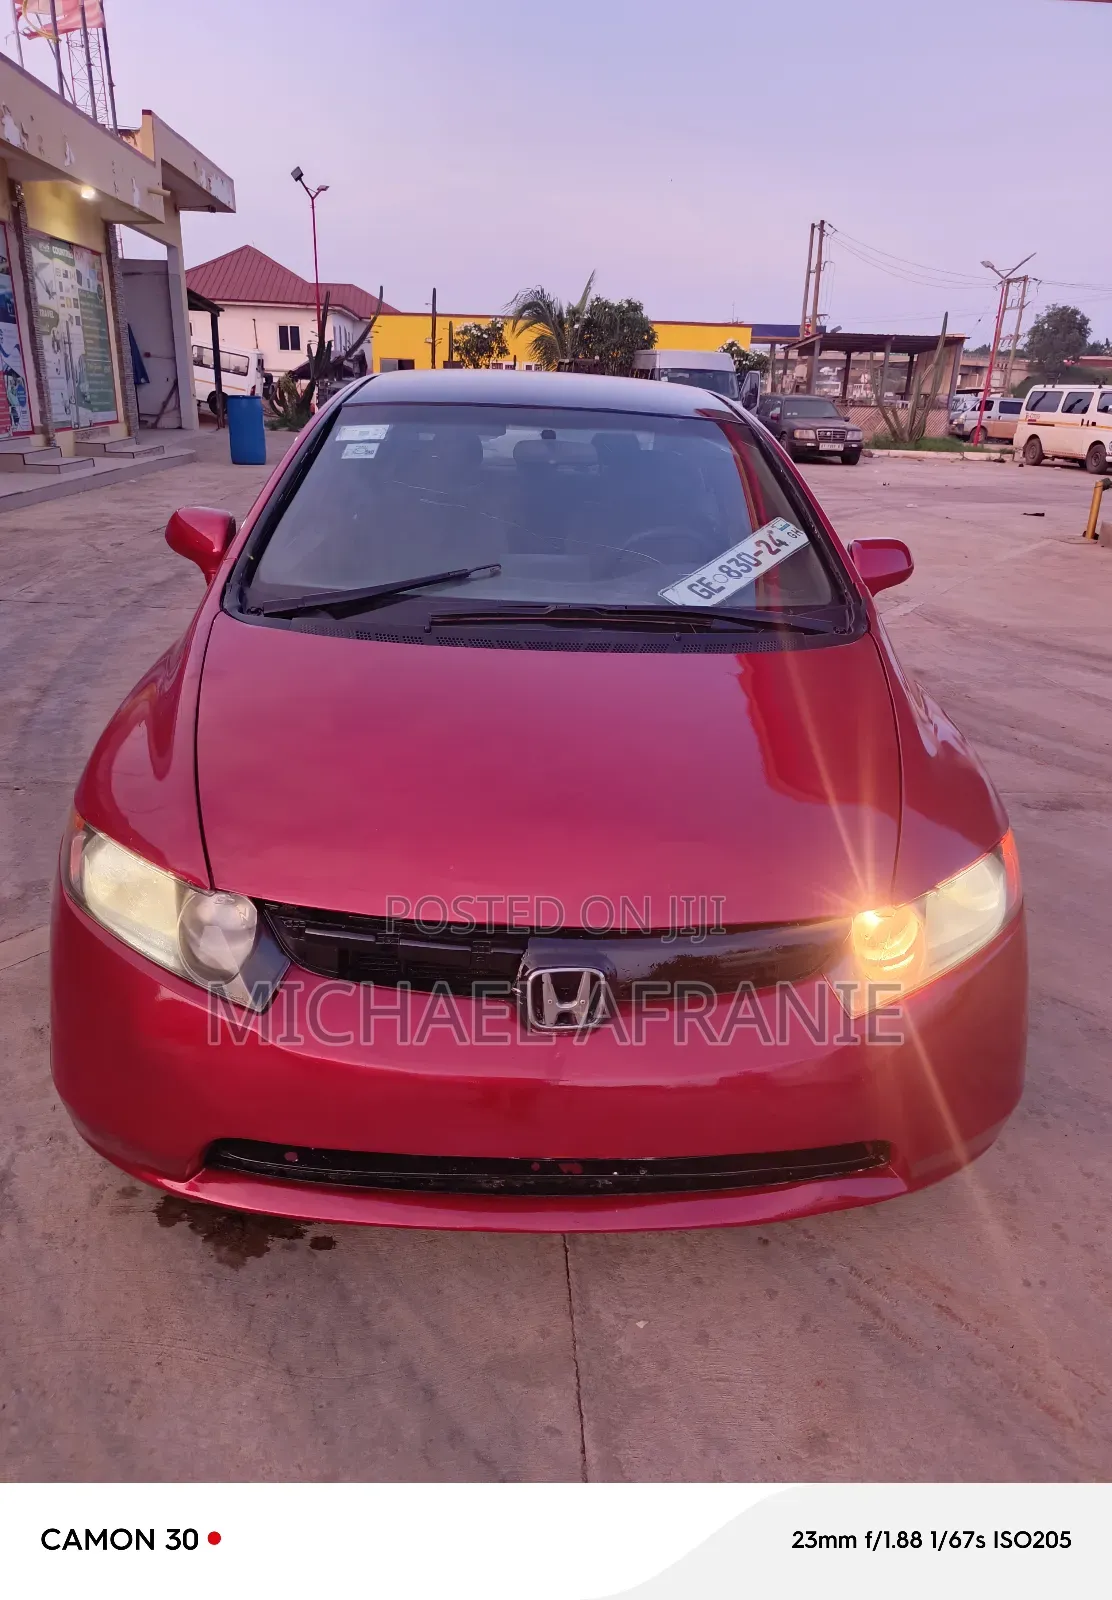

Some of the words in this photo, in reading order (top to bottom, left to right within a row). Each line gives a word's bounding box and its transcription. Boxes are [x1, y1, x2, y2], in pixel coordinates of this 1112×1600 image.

[786, 527, 804, 539] GH
[687, 576, 726, 600] GE
[718, 529, 789, 580] 830-24
